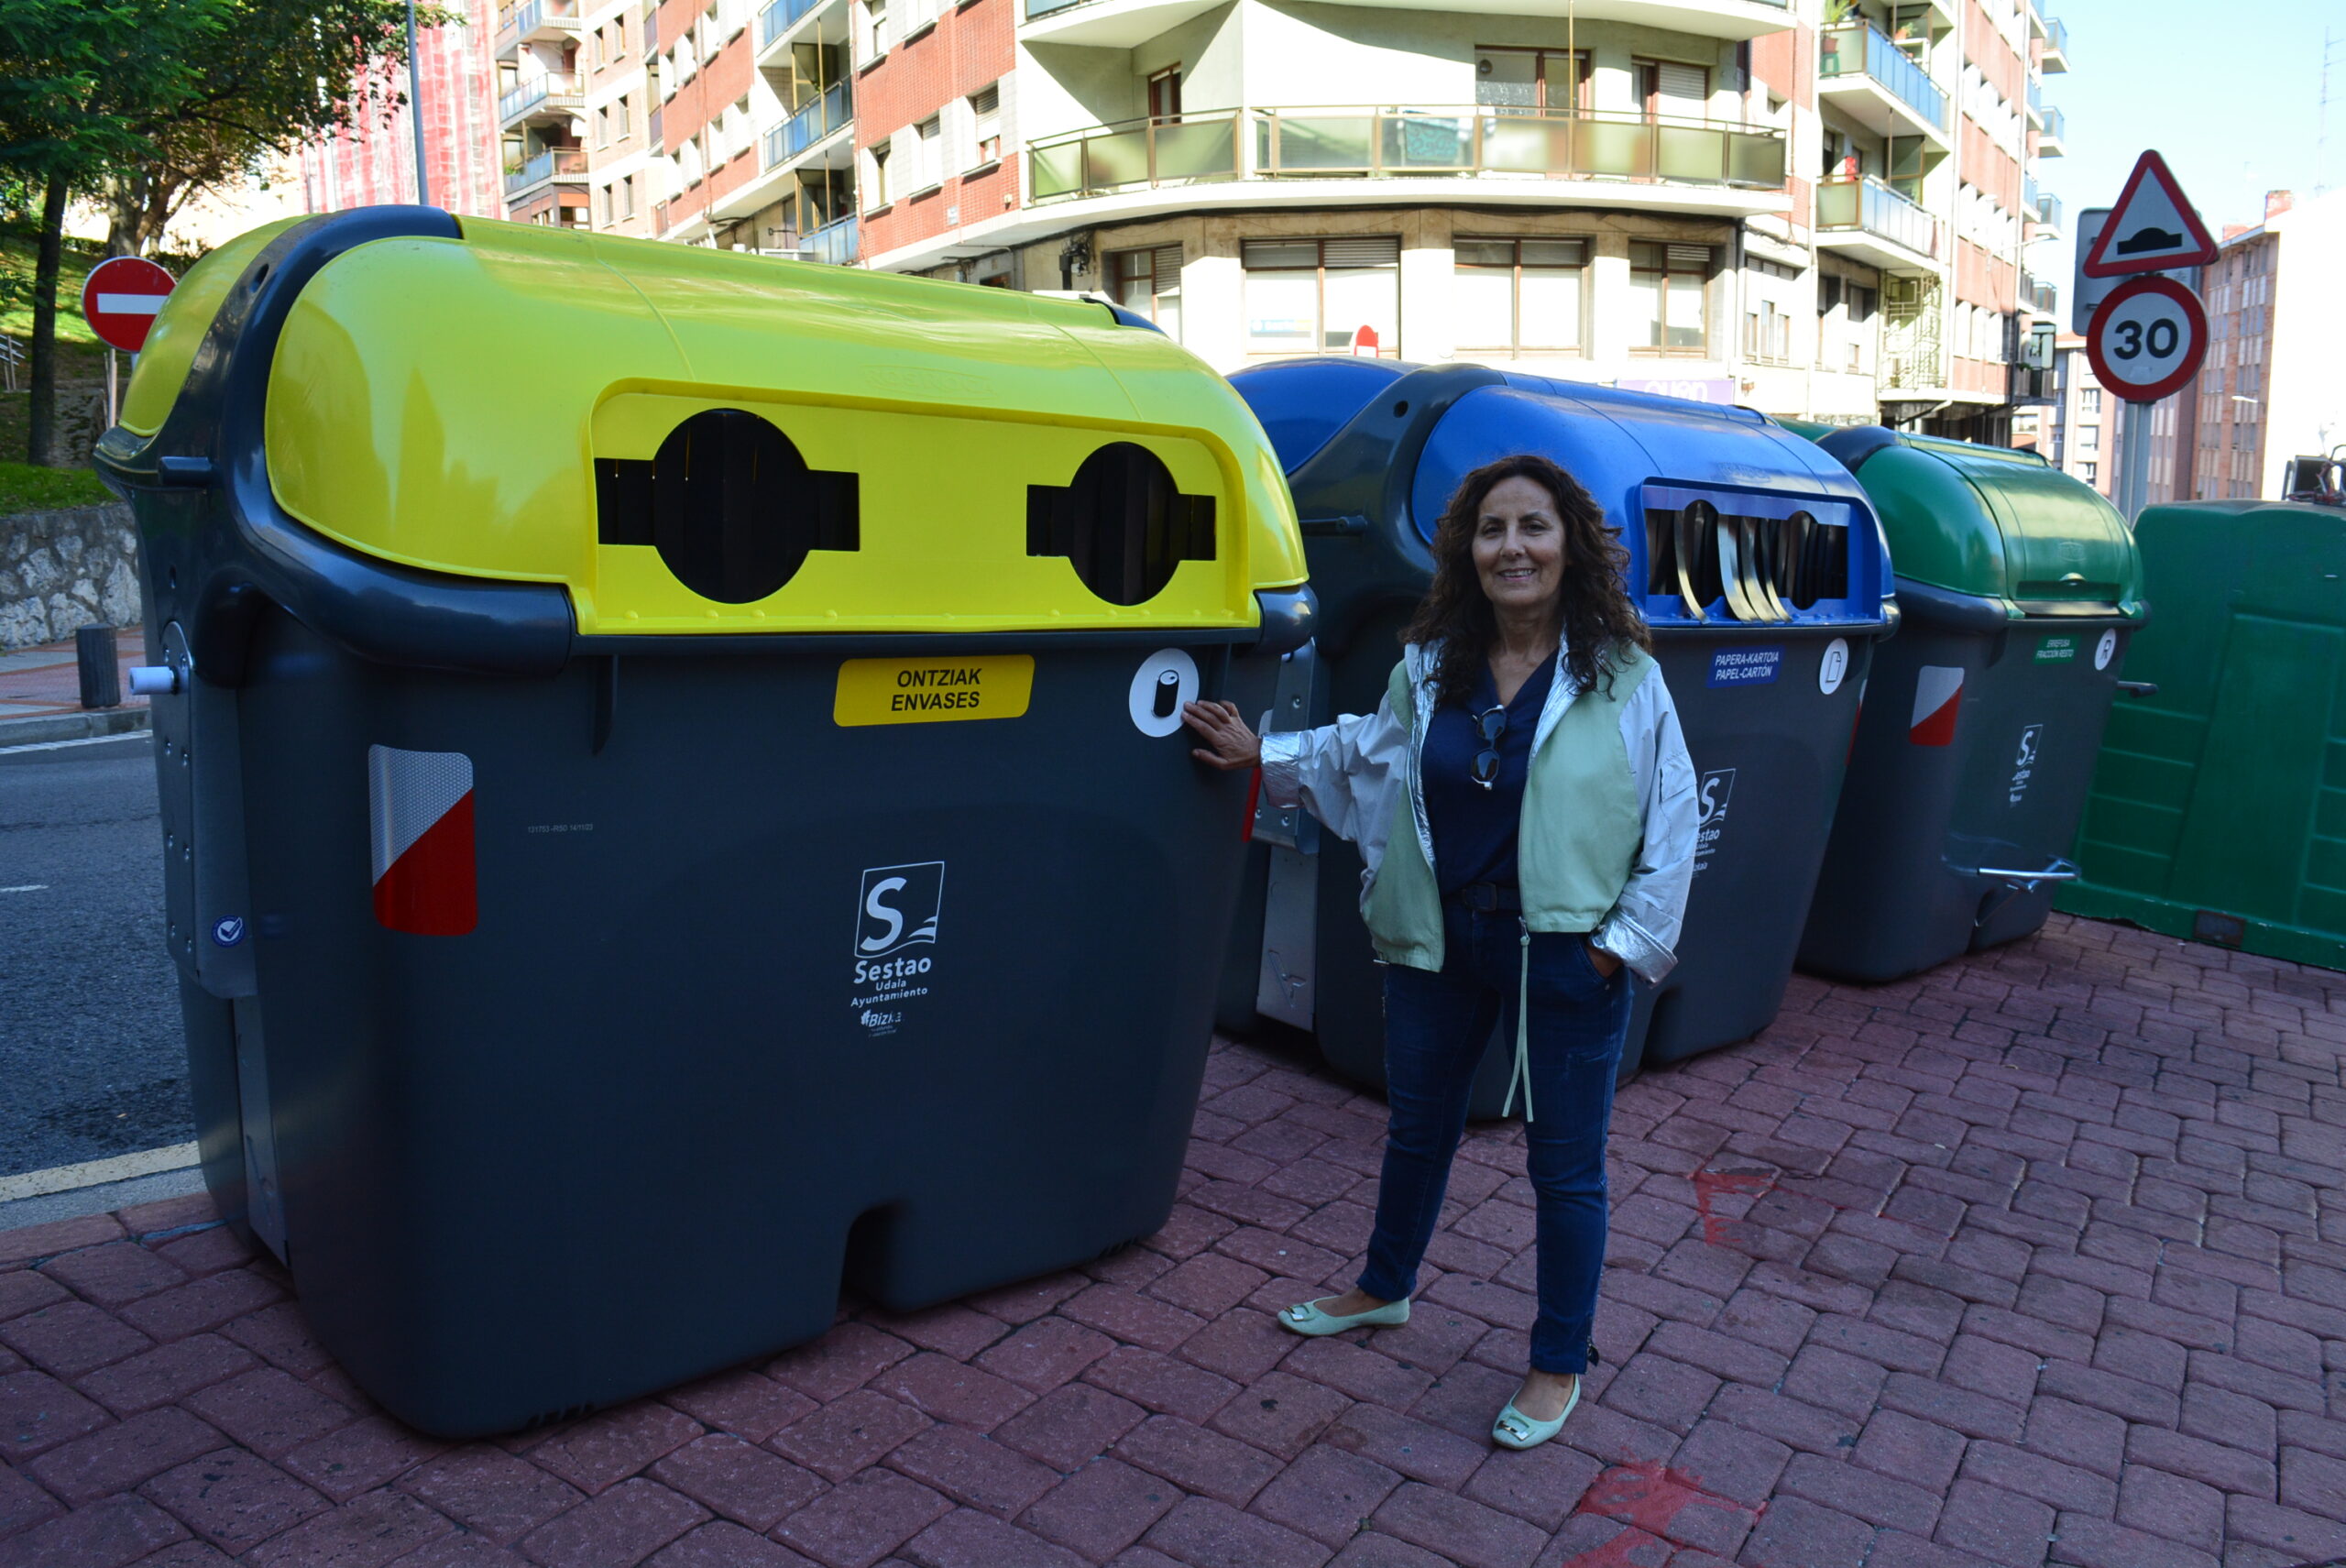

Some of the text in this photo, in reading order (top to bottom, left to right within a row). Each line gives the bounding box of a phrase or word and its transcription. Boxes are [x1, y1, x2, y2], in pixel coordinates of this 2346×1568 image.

[2113, 318, 2179, 359] 30
[1715, 652, 1779, 666] PAPERA-KARTOIA
[897, 668, 981, 687] ONTZIAK
[1715, 663, 1773, 681] PAPEL-CARTÓN
[891, 692, 981, 712] ENVASES
[1696, 828, 1720, 842] estao
[861, 876, 907, 951] S
[853, 956, 932, 984] Sestao
[875, 978, 907, 992] Udala
[850, 986, 928, 1007] Ayuntamiento
